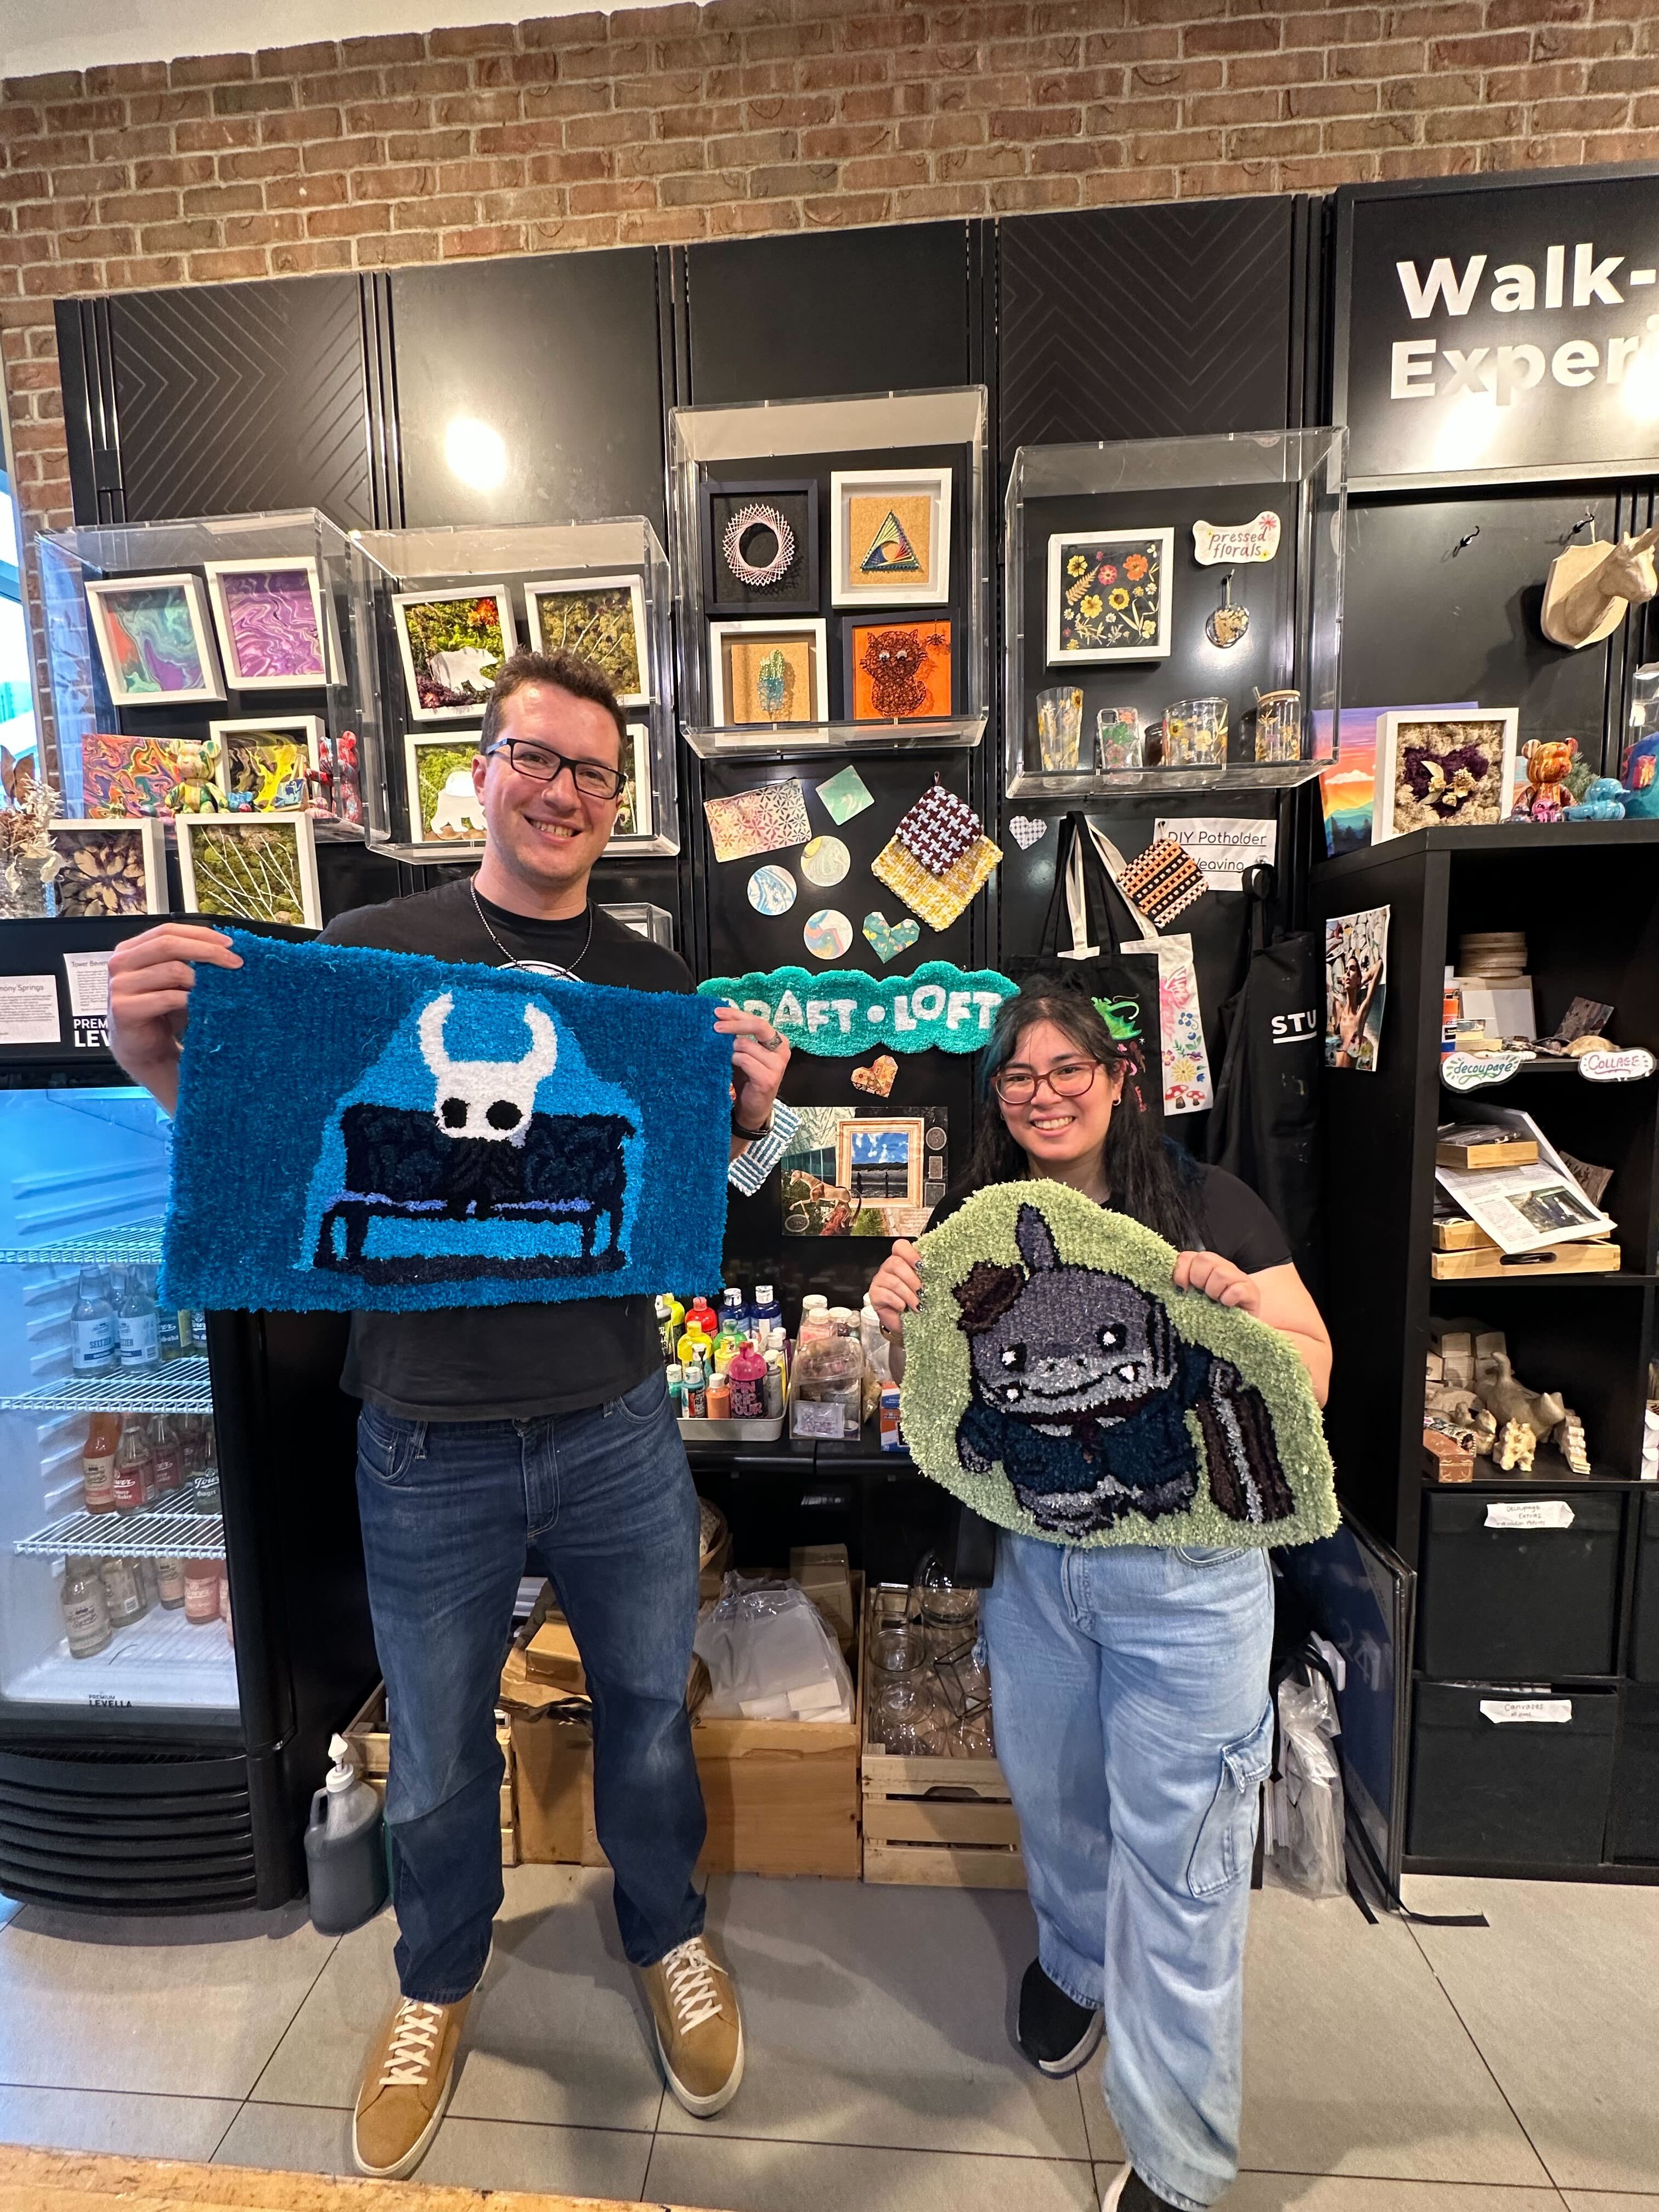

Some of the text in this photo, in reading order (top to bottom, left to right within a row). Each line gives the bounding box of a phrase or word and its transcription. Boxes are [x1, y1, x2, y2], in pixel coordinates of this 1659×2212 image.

[1396, 243, 1656, 319] Walk-
[1209, 526, 1267, 550] pressed
[1214, 543, 1261, 558] florals
[1168, 831, 1267, 844] DIY Potholder
[18, 984, 44, 992] Springs
[721, 985, 1002, 1034] RAFT LOFT
[74, 1018, 108, 1029] PREM
[1271, 1009, 1316, 1035] STU
[1454, 1061, 1513, 1076] decoupage
[89, 1700, 132, 1708] LEVELLA
